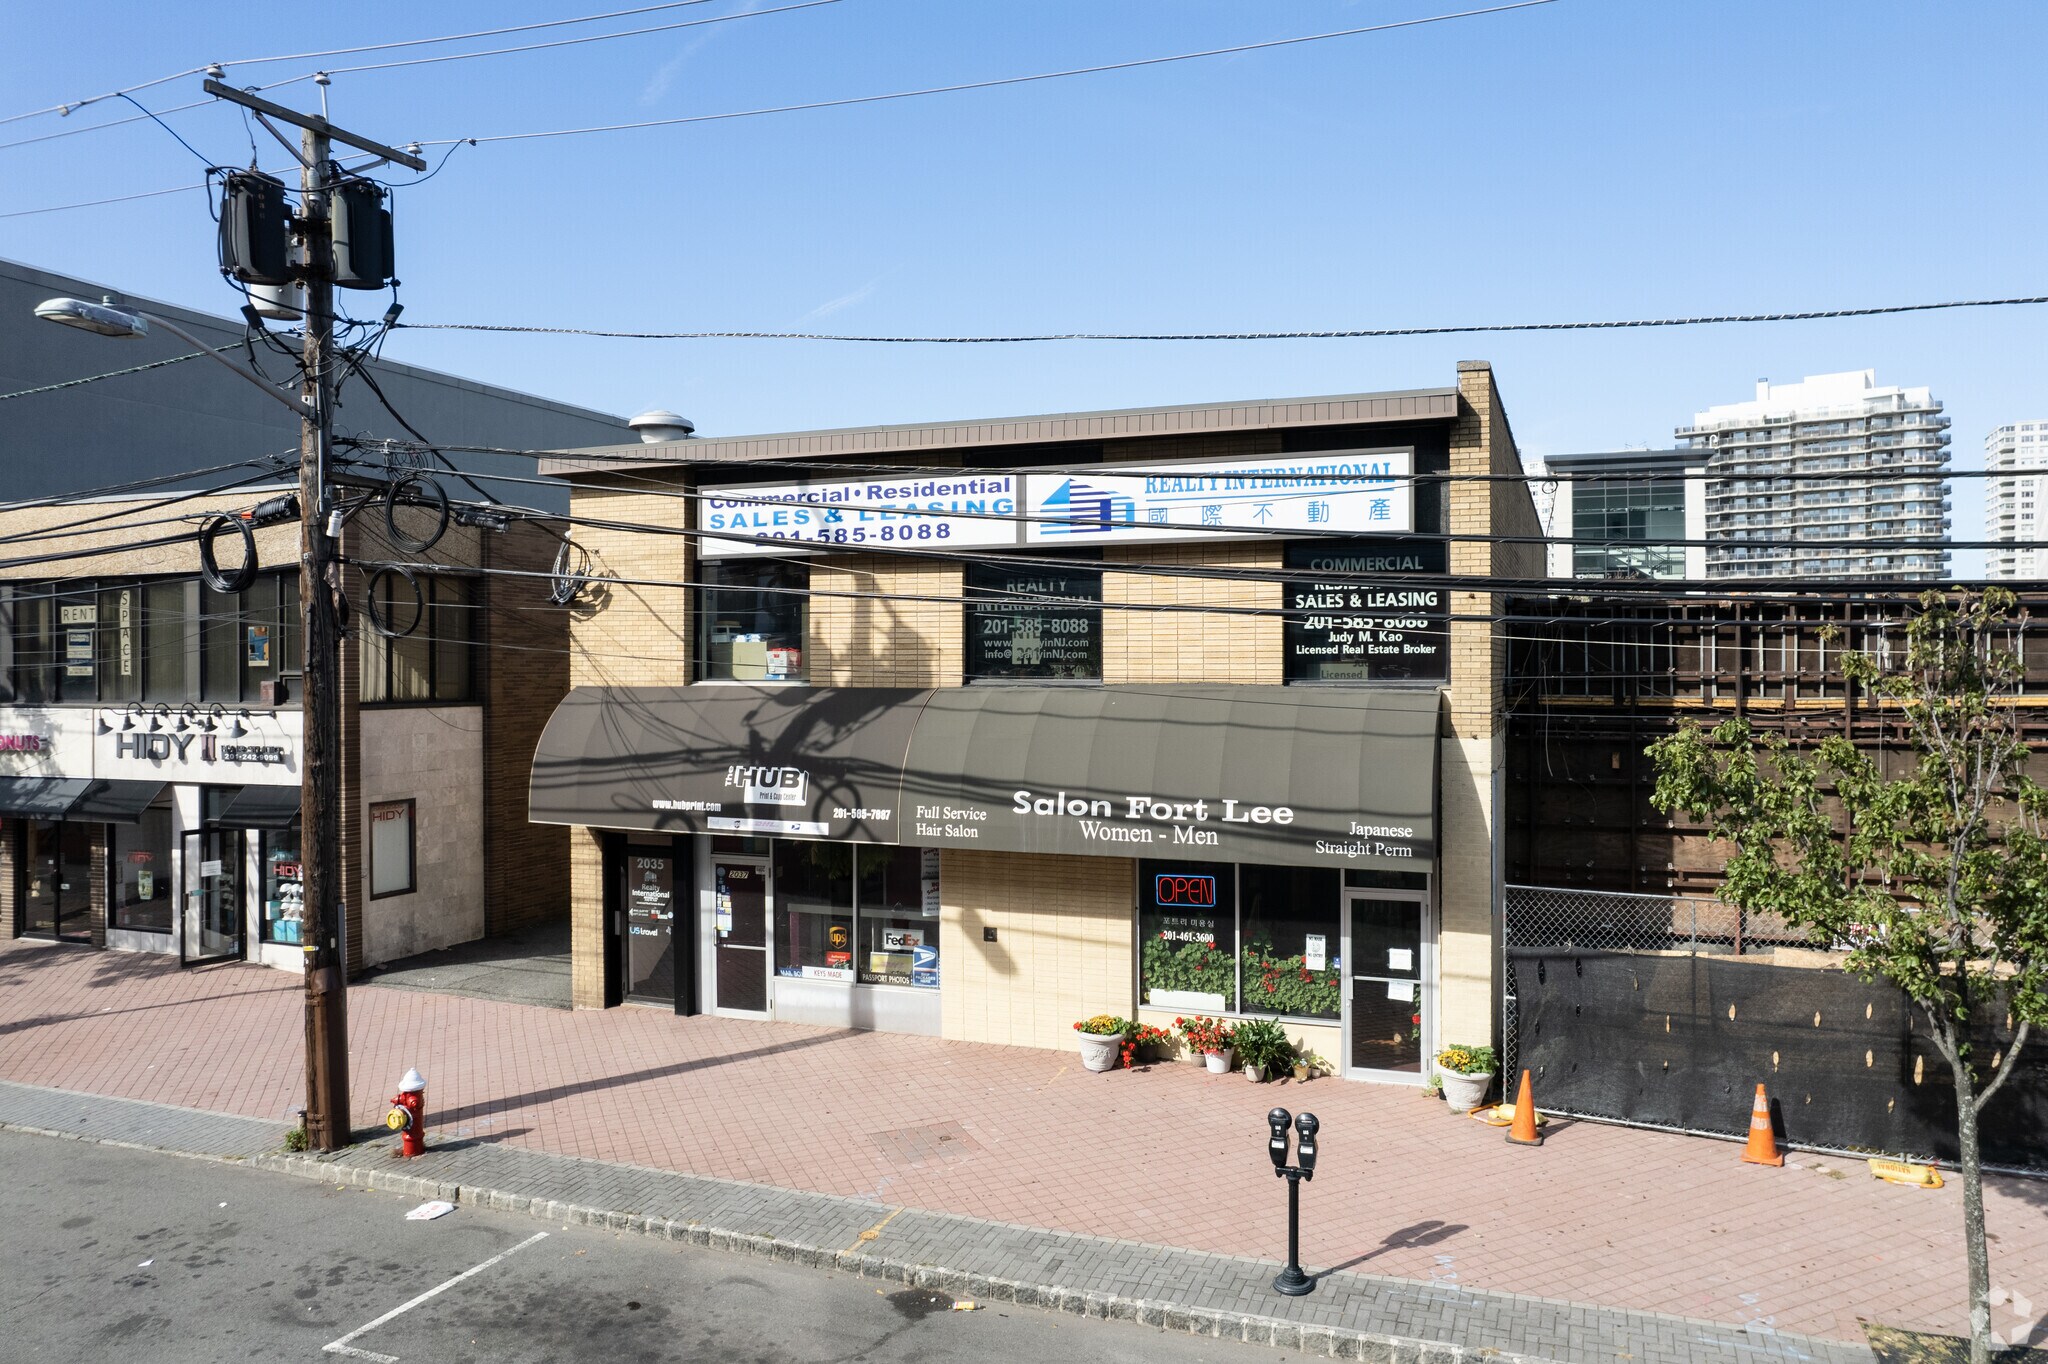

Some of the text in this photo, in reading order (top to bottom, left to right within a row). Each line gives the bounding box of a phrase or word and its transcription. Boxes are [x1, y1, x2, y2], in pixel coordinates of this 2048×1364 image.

[1145, 462, 1396, 494] REALTY INTERNATIONAL
[867, 477, 1010, 500] Residential
[710, 498, 1014, 529] SALES & LEASING
[1311, 556, 1424, 571] COMMERCIAL
[1007, 577, 1068, 592] REALTY
[1295, 592, 1438, 609] SALES & LEASING
[63, 608, 96, 621] RENT
[1304, 612, 1428, 629] 201-585-8088
[121, 593, 130, 673] SPACE
[984, 618, 1088, 634] 201-585-8088
[984, 638, 1089, 649] www.yinNJ.com
[1328, 631, 1403, 644] Judy M. Kao
[985, 649, 1088, 660] info@ealyinNJ.com
[1296, 644, 1436, 655] Licensed Real Estate Broker
[116, 732, 196, 761] HIDY
[725, 765, 734, 787] The
[734, 766, 801, 788] HUB
[653, 799, 722, 812] www.hubprint.com
[916, 805, 987, 821] Full Service
[1013, 790, 1294, 824] Salon Fort Lee
[372, 808, 405, 822] HIDY
[916, 823, 978, 838] Hair Salon
[1079, 820, 1153, 842] Women
[1173, 825, 1219, 845] Men
[1349, 821, 1413, 839] Japanese
[1316, 840, 1412, 858] Straight Perm
[637, 858, 664, 870] 2035
[631, 889, 670, 899] International
[641, 884, 661, 892] Realty
[1158, 877, 1213, 904] OPEN
[831, 933, 846, 946] ups
[885, 932, 920, 946] FedEx
[1163, 930, 1215, 943] 201-461-3600
[814, 969, 842, 978] KEYS MADE
[862, 973, 910, 984] PASSPORT PHOTOS
